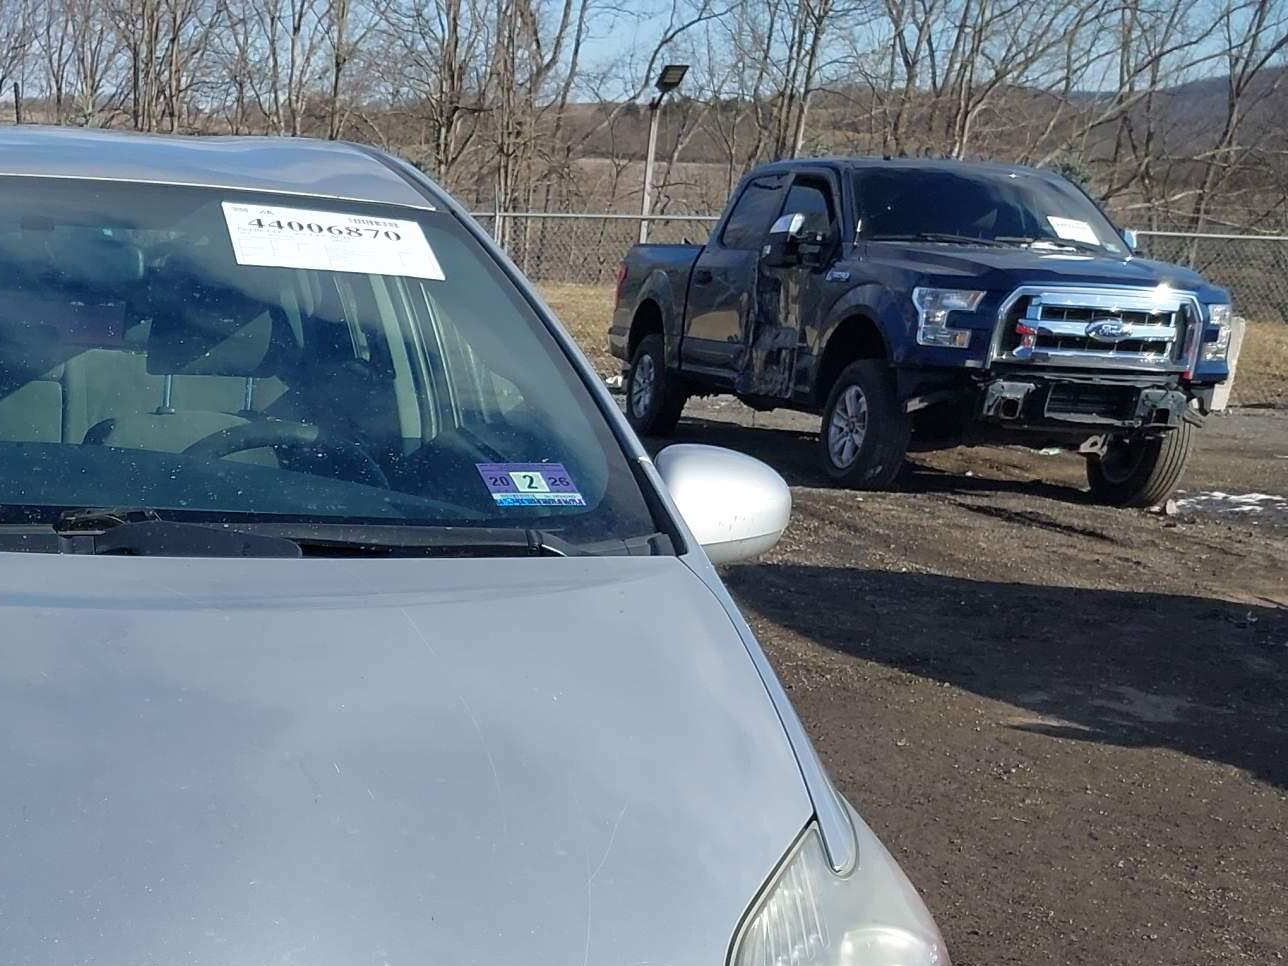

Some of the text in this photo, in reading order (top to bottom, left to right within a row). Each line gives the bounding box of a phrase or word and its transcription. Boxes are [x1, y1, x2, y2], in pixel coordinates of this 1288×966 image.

[247, 217, 402, 242] 44006870
[489, 474, 570, 490] 20 2 26
